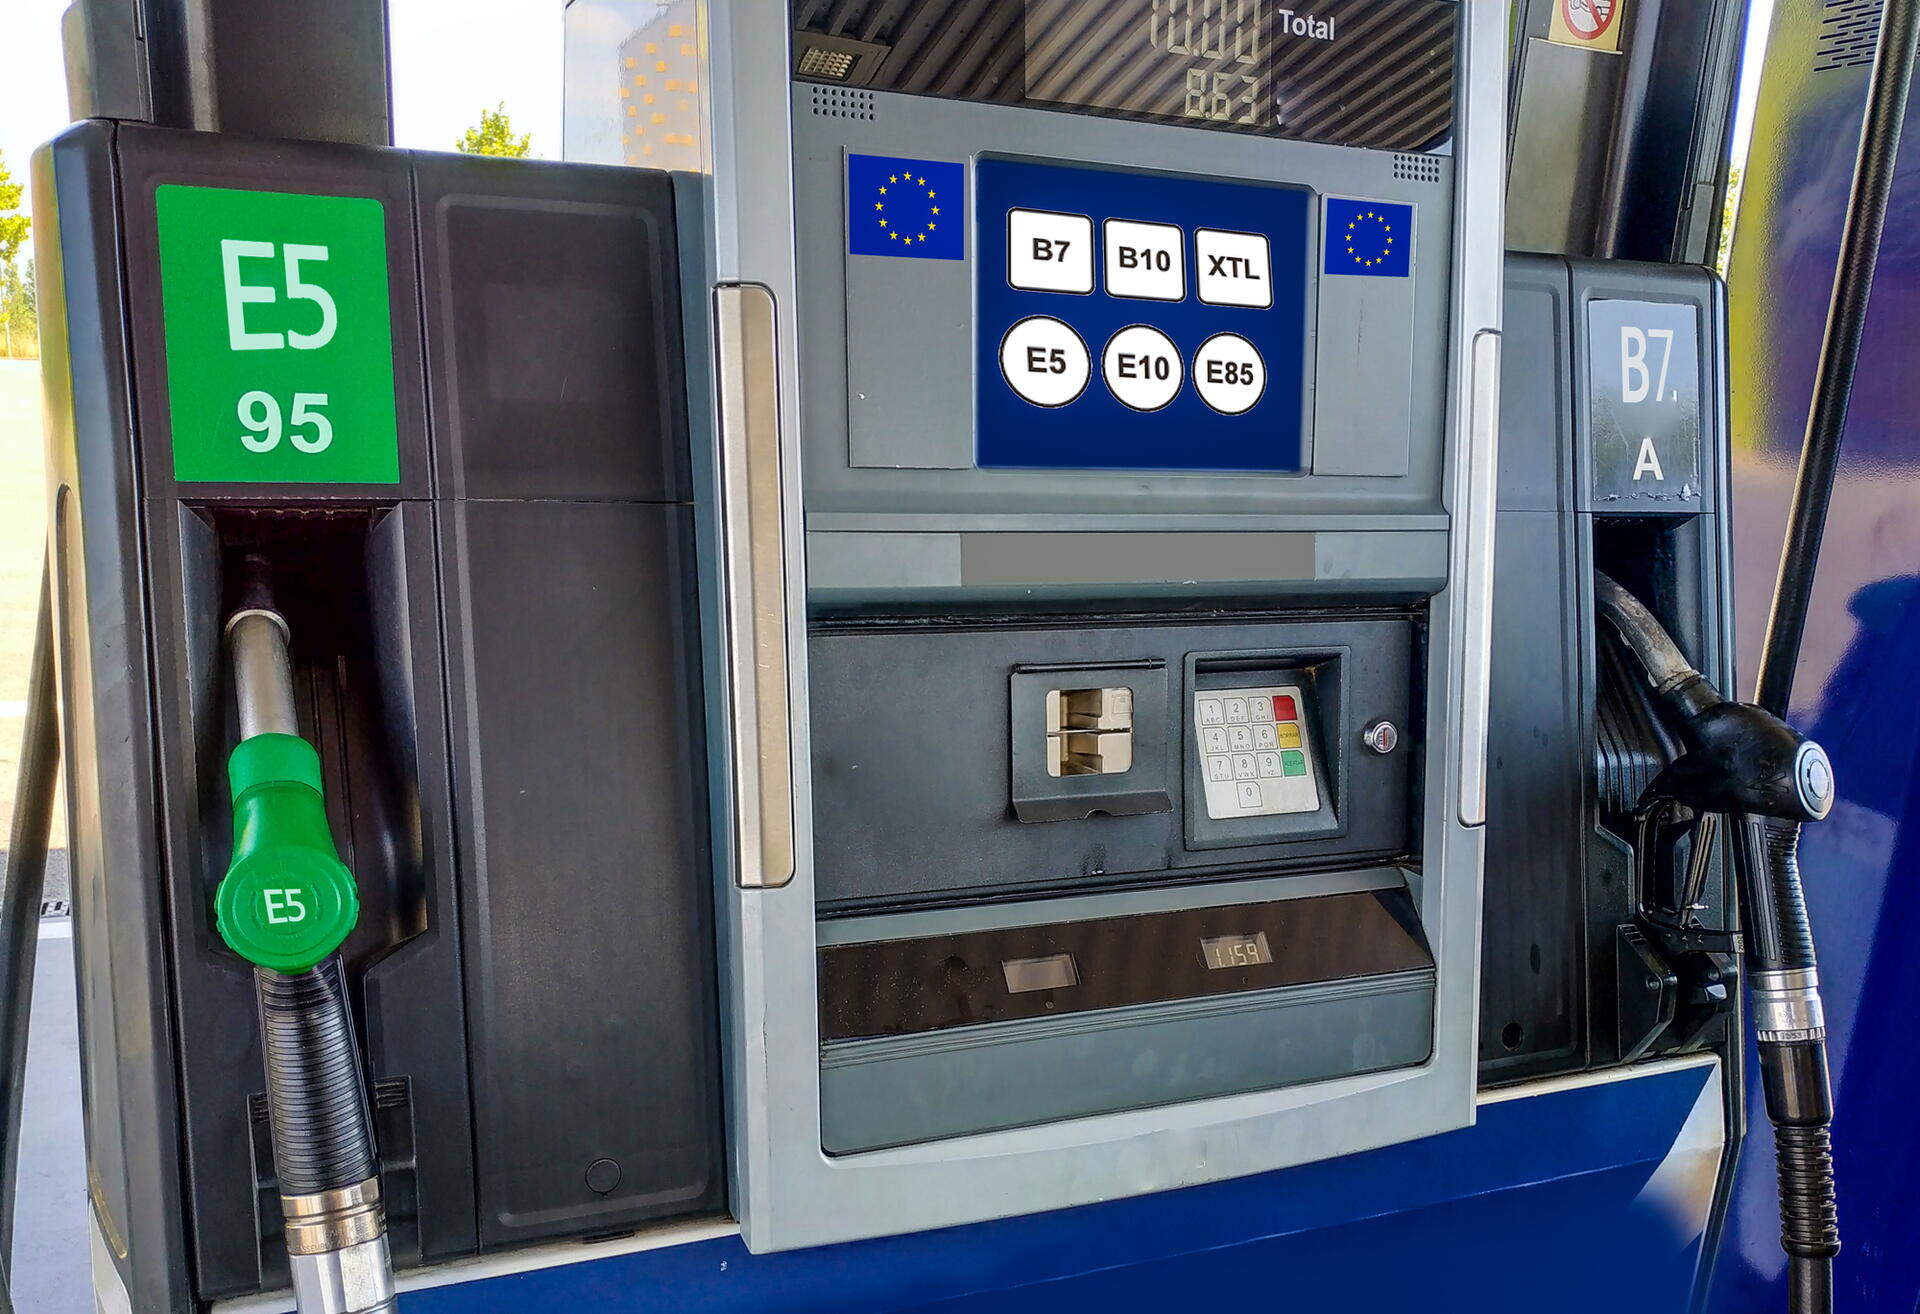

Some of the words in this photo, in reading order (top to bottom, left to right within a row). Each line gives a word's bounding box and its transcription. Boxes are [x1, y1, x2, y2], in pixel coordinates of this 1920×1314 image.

[1278, 8, 1335, 40] Total
[1032, 237, 1071, 263] B7
[1119, 246, 1171, 272] B10
[1207, 254, 1261, 280] XTL
[221, 238, 338, 351] E5
[1026, 346, 1067, 374] E5
[1117, 353, 1170, 381] E10
[1206, 359, 1254, 386] E85
[237, 390, 333, 453] 95
[1632, 437, 1665, 481] A
[1209, 704, 1214, 714] 1
[1233, 703, 1240, 713] 2
[1257, 701, 1264, 711] 3
[1212, 732, 1219, 742] 4
[1237, 730, 1244, 740] 5
[1261, 729, 1268, 739] 6
[1216, 760, 1223, 770] 7
[1241, 758, 1248, 769] 8
[1265, 757, 1272, 767] 9
[1245, 786, 1253, 797] 0
[263, 888, 306, 924] E5
